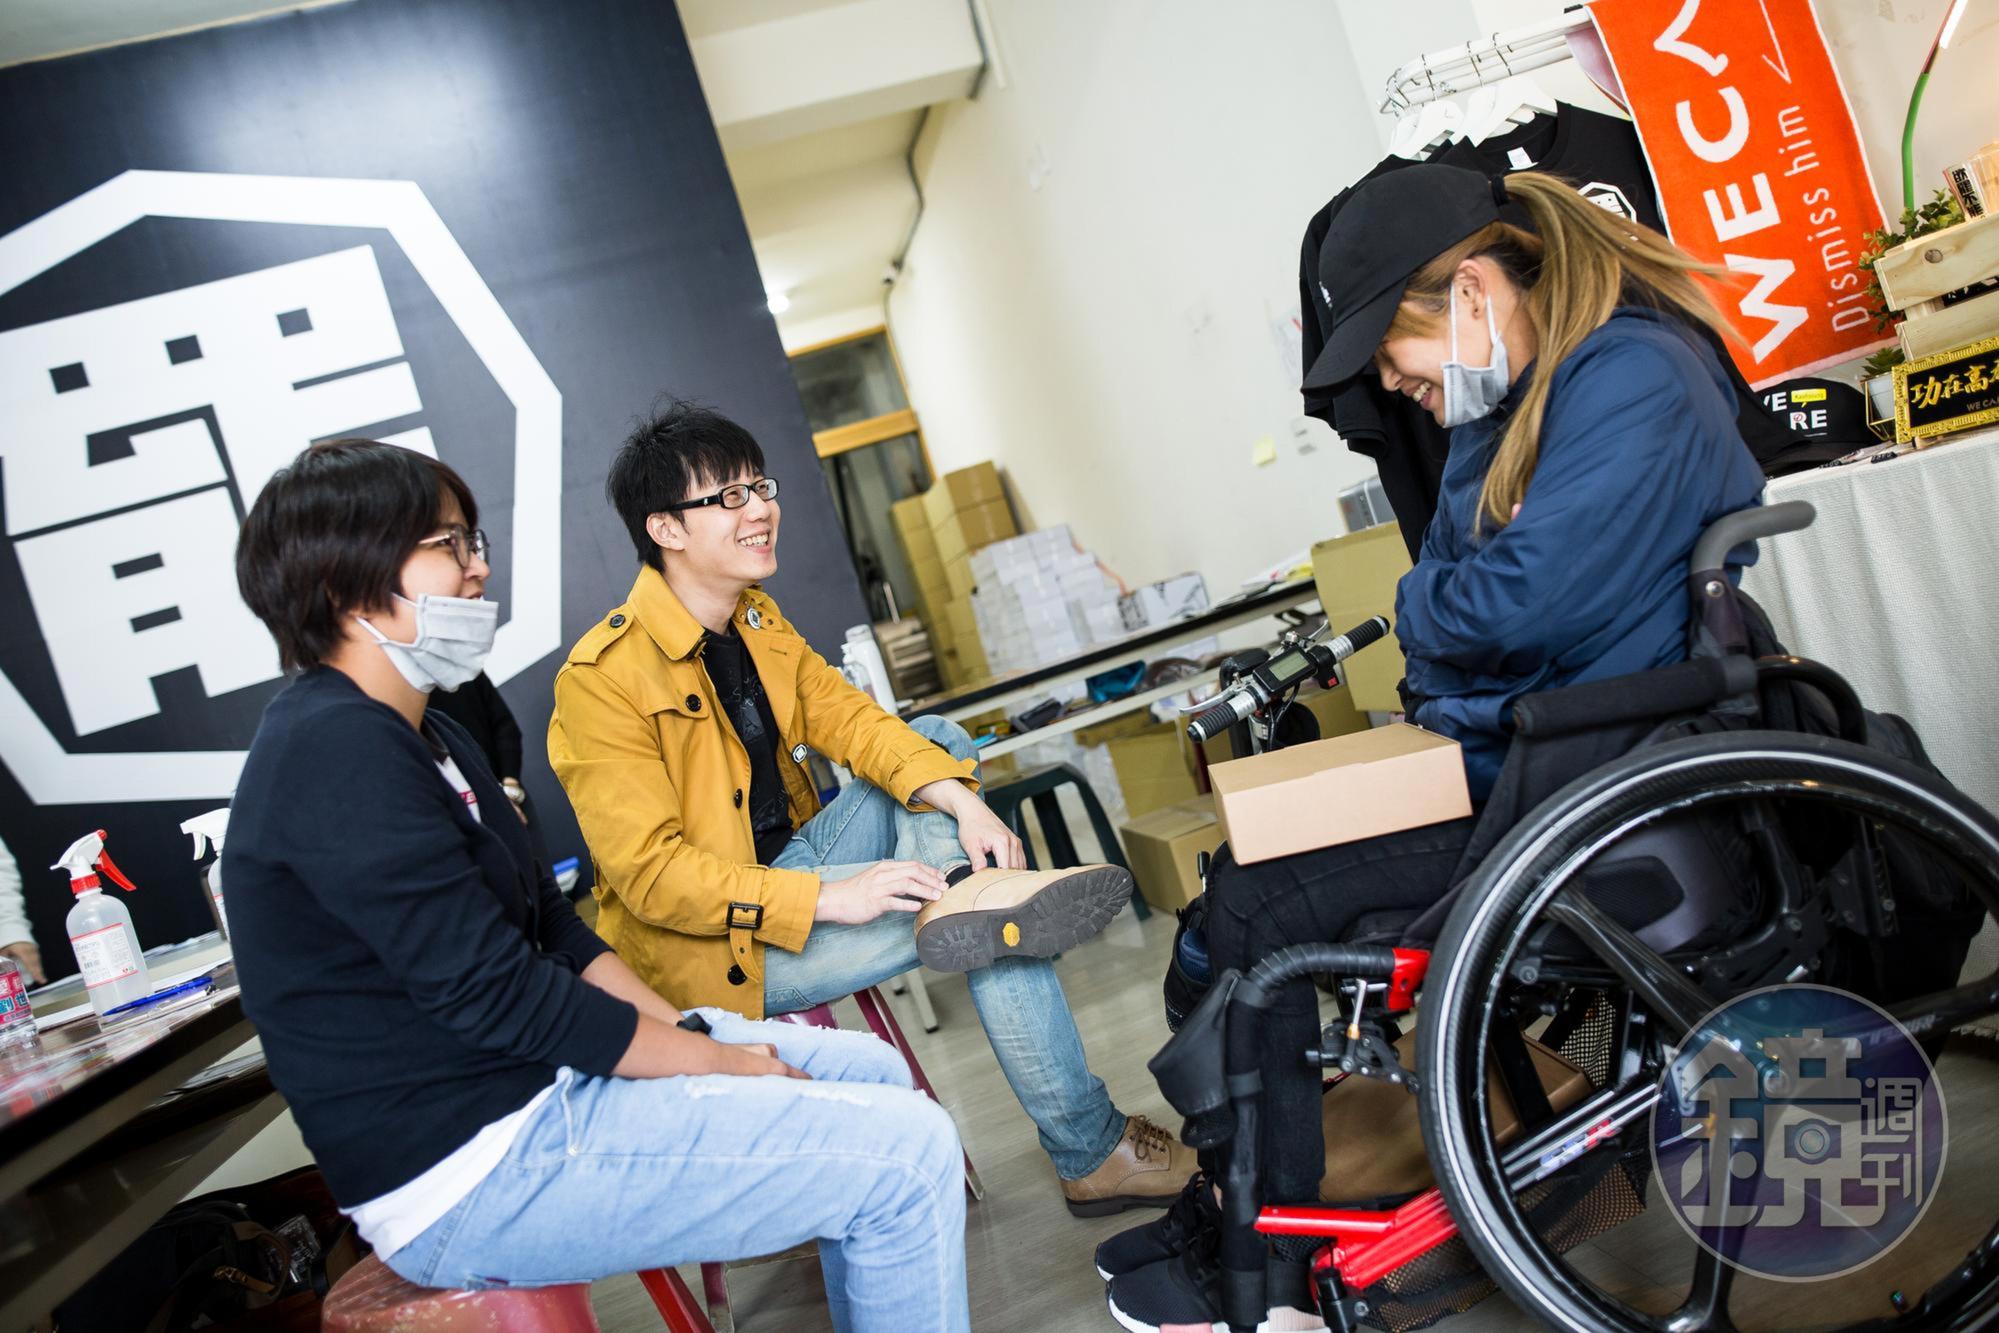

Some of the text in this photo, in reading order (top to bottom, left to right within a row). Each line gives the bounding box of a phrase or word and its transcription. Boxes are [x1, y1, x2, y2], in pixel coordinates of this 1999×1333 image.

[1702, 172, 1809, 365] WE
[1778, 105, 1871, 333] Dismiss him
